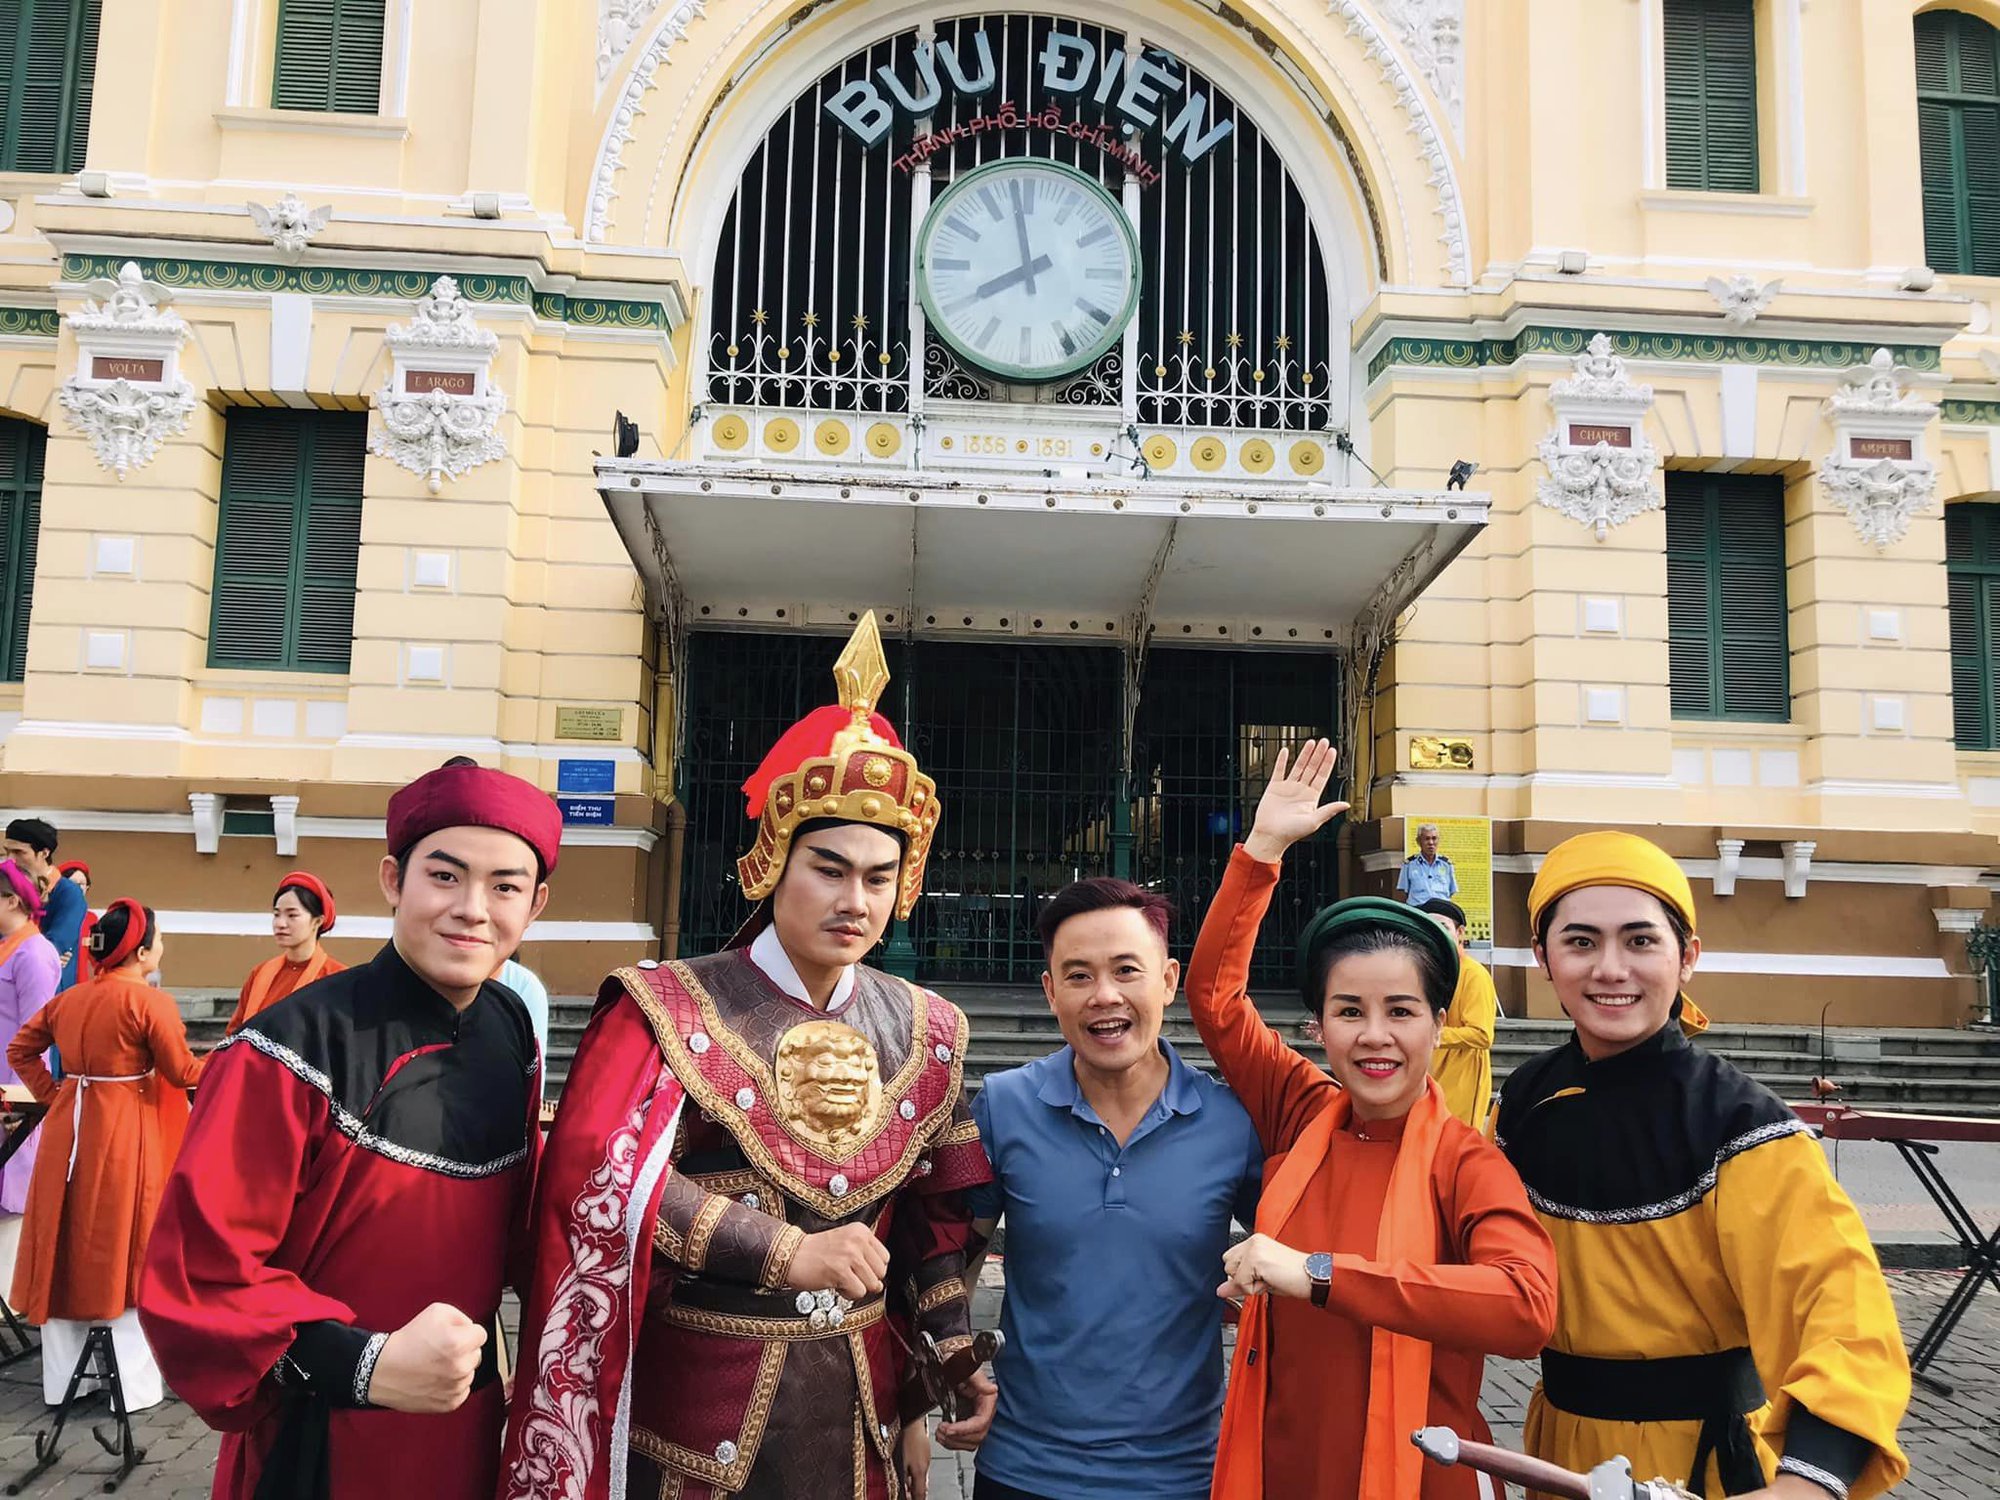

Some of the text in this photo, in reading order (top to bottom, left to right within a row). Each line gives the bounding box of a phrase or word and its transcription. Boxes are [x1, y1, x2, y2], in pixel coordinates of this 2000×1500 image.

[823, 30, 1234, 163] BƯU ĐIỆN
[892, 100, 1161, 185] THÀNH PHỐ HỒ CHÍ MINH
[108, 362, 145, 374] VOLTA
[427, 376, 466, 388] ARAGO
[1579, 429, 1622, 441] CHAPPE
[1036, 437, 1073, 457] 1891
